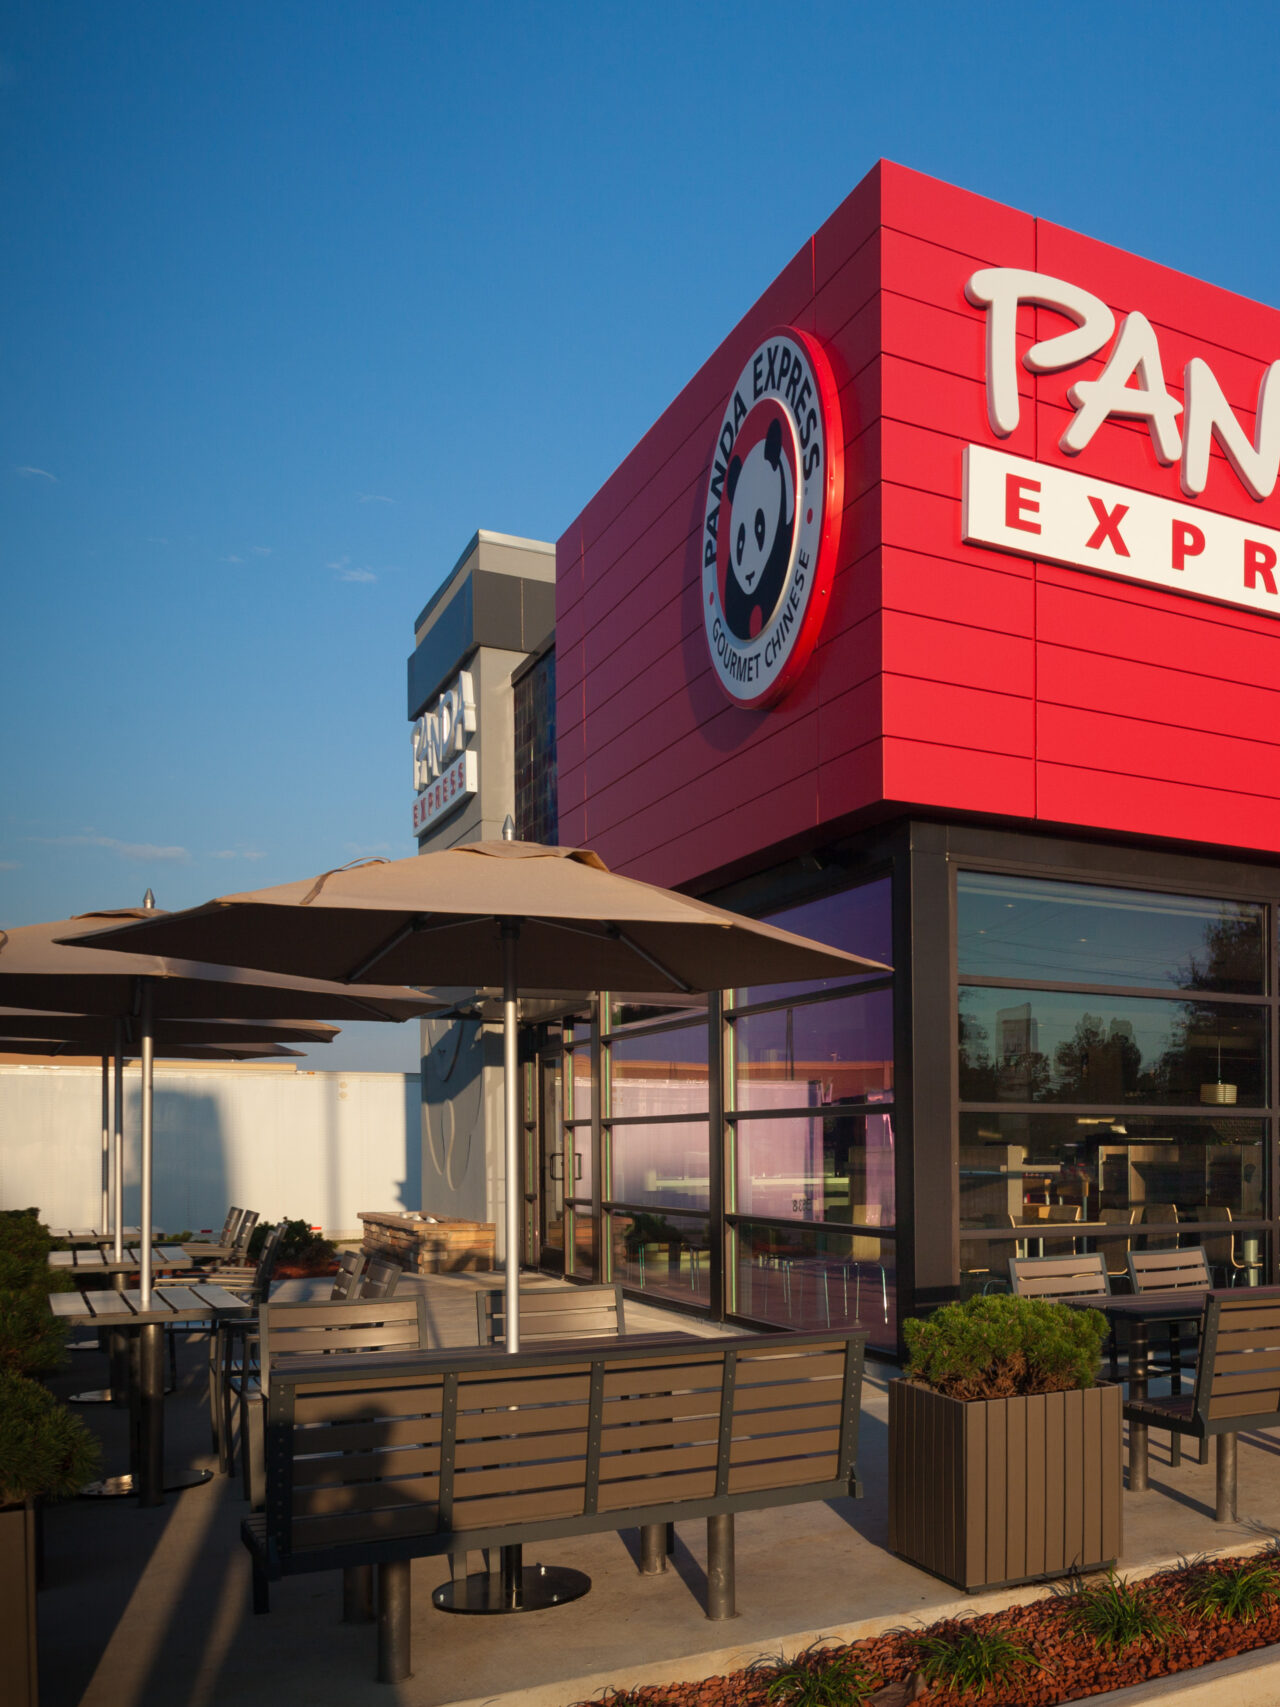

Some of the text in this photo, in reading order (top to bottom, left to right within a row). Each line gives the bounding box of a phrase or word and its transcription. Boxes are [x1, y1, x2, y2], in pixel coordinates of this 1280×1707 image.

[704, 344, 820, 569] PANDA EXPRESS
[712, 549, 810, 683] GOURMET CHINESE
[411, 670, 476, 791] PANDA
[413, 761, 464, 828] EXPRESS
